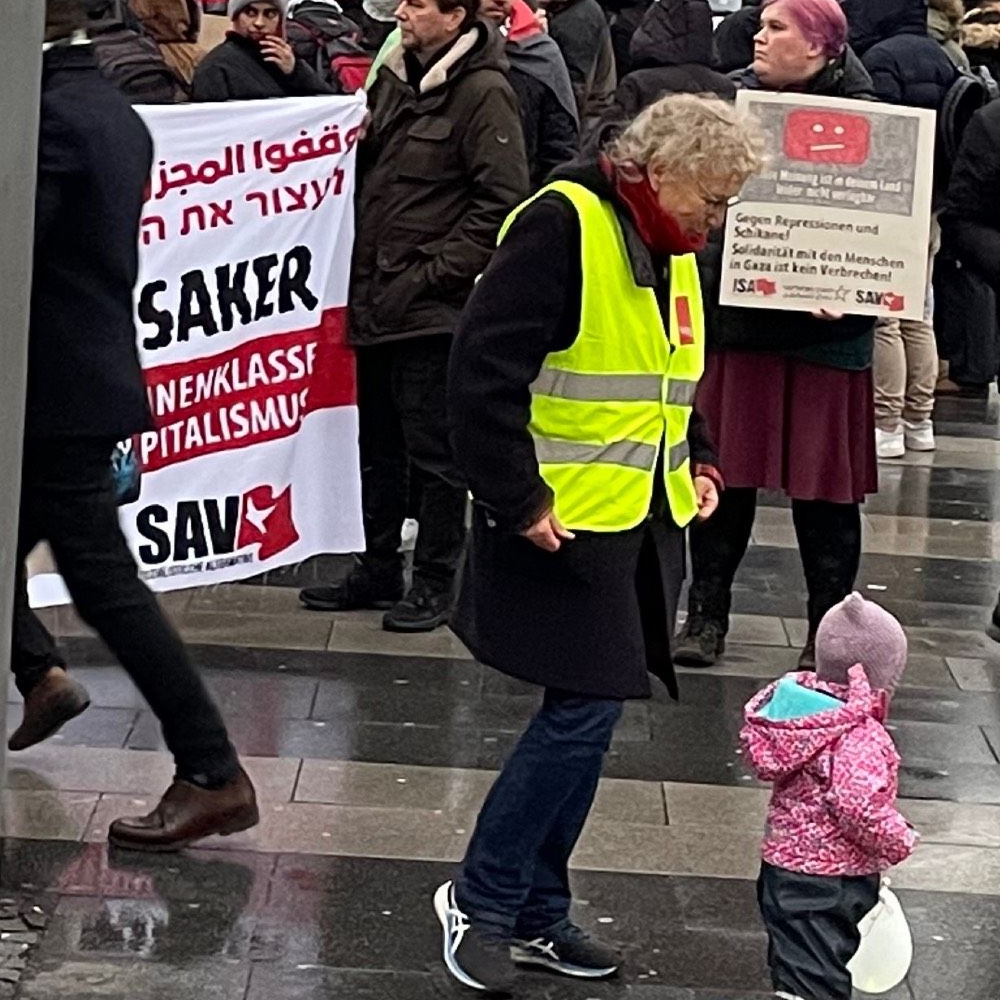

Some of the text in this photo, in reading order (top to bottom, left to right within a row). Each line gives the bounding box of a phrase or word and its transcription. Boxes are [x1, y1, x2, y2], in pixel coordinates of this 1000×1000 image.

[144, 124, 366, 200] وقفوا المجز
[141, 215, 165, 245] ה
[180, 200, 233, 235] את
[735, 212, 879, 236] Gegen Repressionen und
[729, 259, 893, 283] in Gaza ist kein Verbrechen!
[732, 242, 905, 270] Solidarität mit den Menschen
[137, 244, 318, 350] SAKER
[732, 278, 755, 293] ISA
[136, 495, 240, 565] SAV
